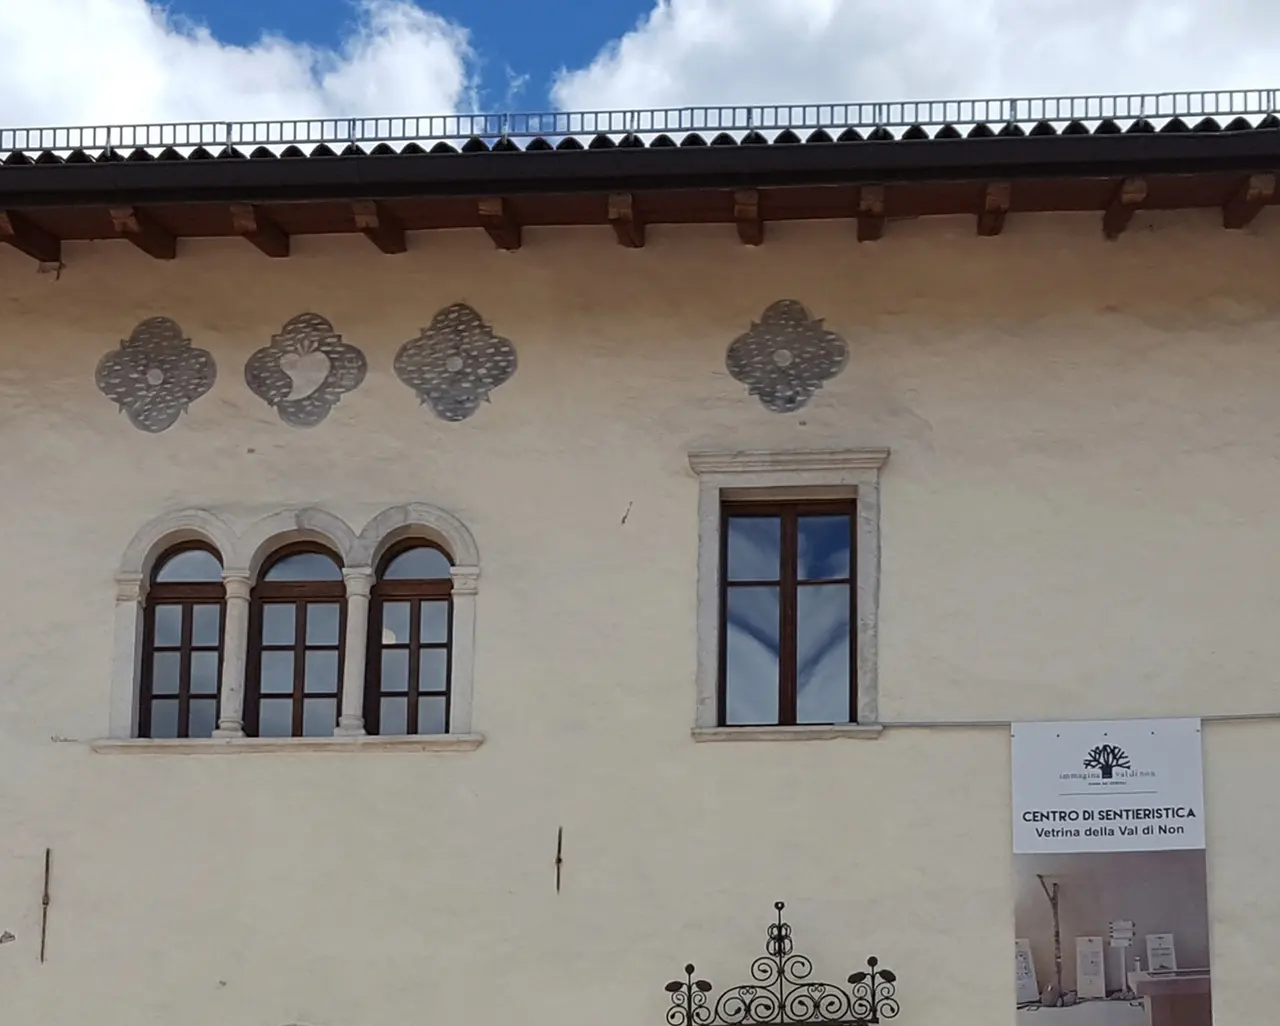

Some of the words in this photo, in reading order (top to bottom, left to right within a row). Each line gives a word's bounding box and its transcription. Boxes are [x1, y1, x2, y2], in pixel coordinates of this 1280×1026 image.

[1022, 810, 1079, 823] CENTRO
[1083, 810, 1095, 821] DI
[1098, 807, 1196, 820] SENTIERISTICA
[1035, 827, 1081, 838] Vetrina
[1085, 826, 1114, 837] della
[1119, 825, 1139, 836] Val
[1142, 824, 1154, 835] di
[1158, 824, 1185, 835] Non
